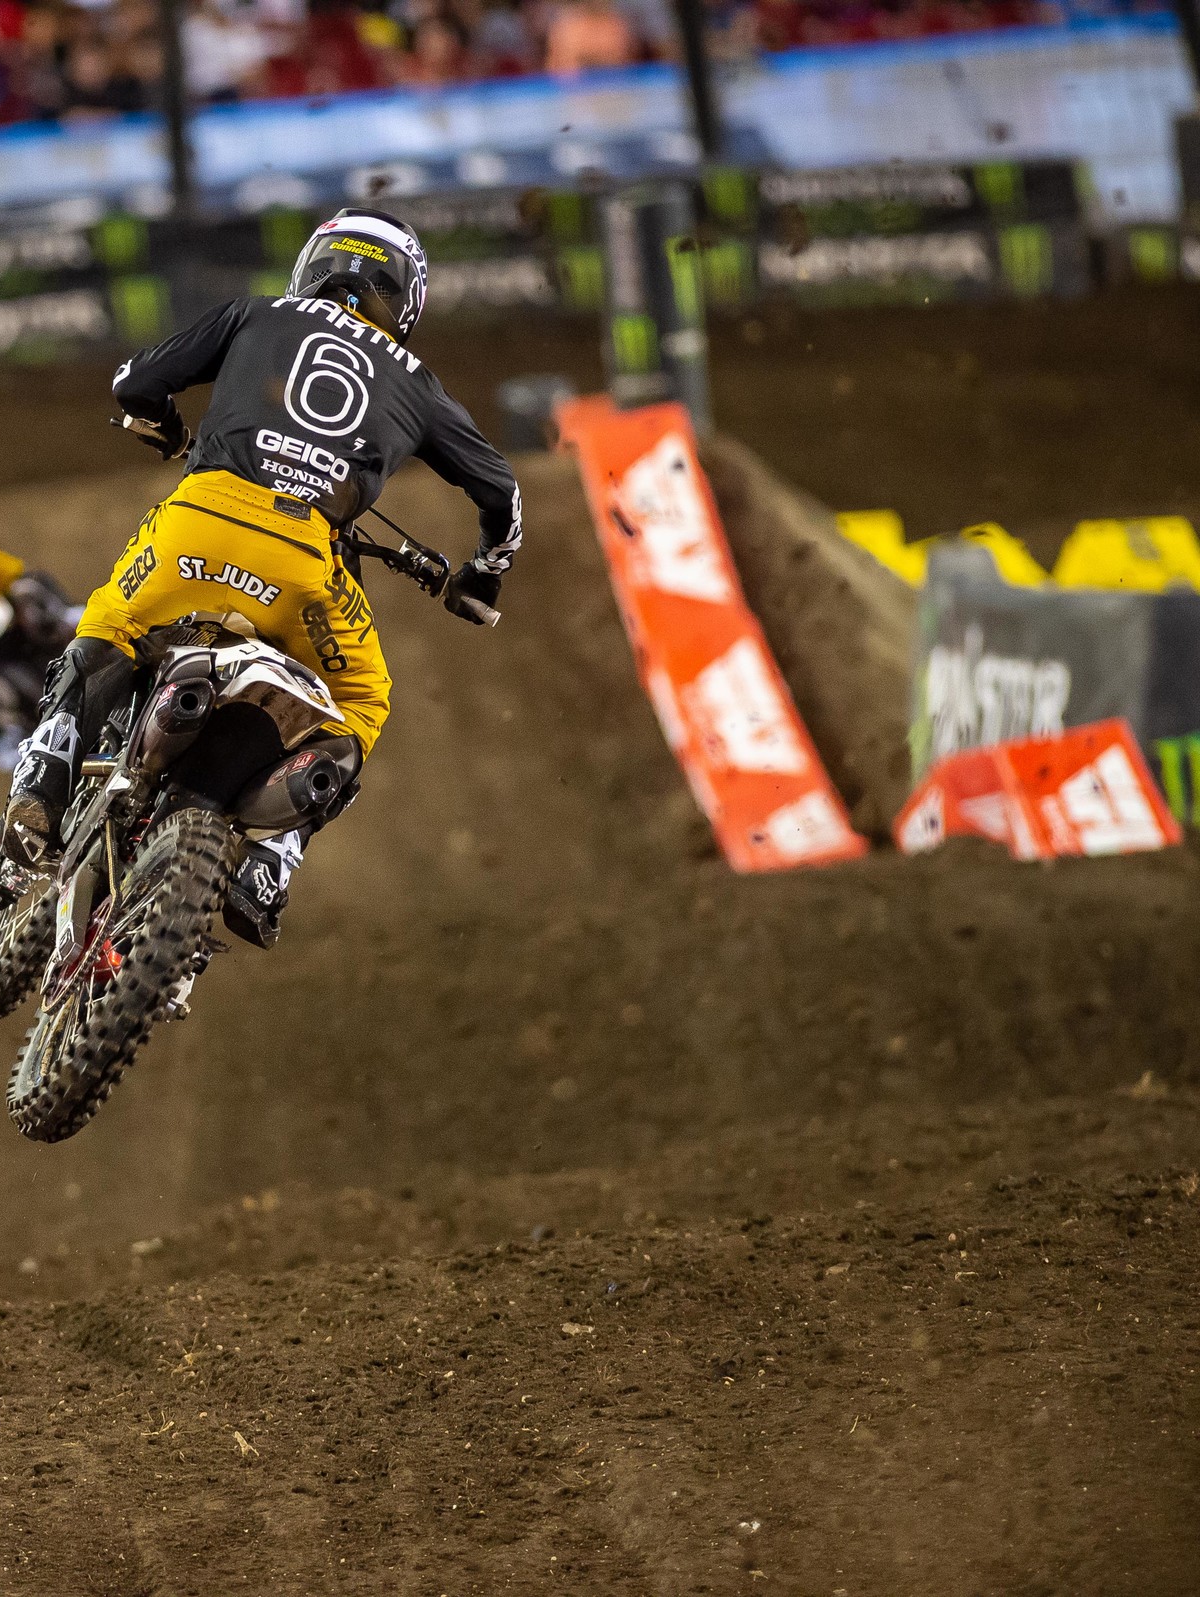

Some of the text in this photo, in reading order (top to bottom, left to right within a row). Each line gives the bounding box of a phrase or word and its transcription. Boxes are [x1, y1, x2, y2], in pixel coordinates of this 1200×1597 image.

[284, 332, 375, 437] 6
[256, 429, 350, 482] GEICO
[261, 458, 335, 495] HONDA
[270, 479, 321, 503] SHIFT
[118, 545, 157, 601] GEICO
[302, 601, 348, 673] GEICO
